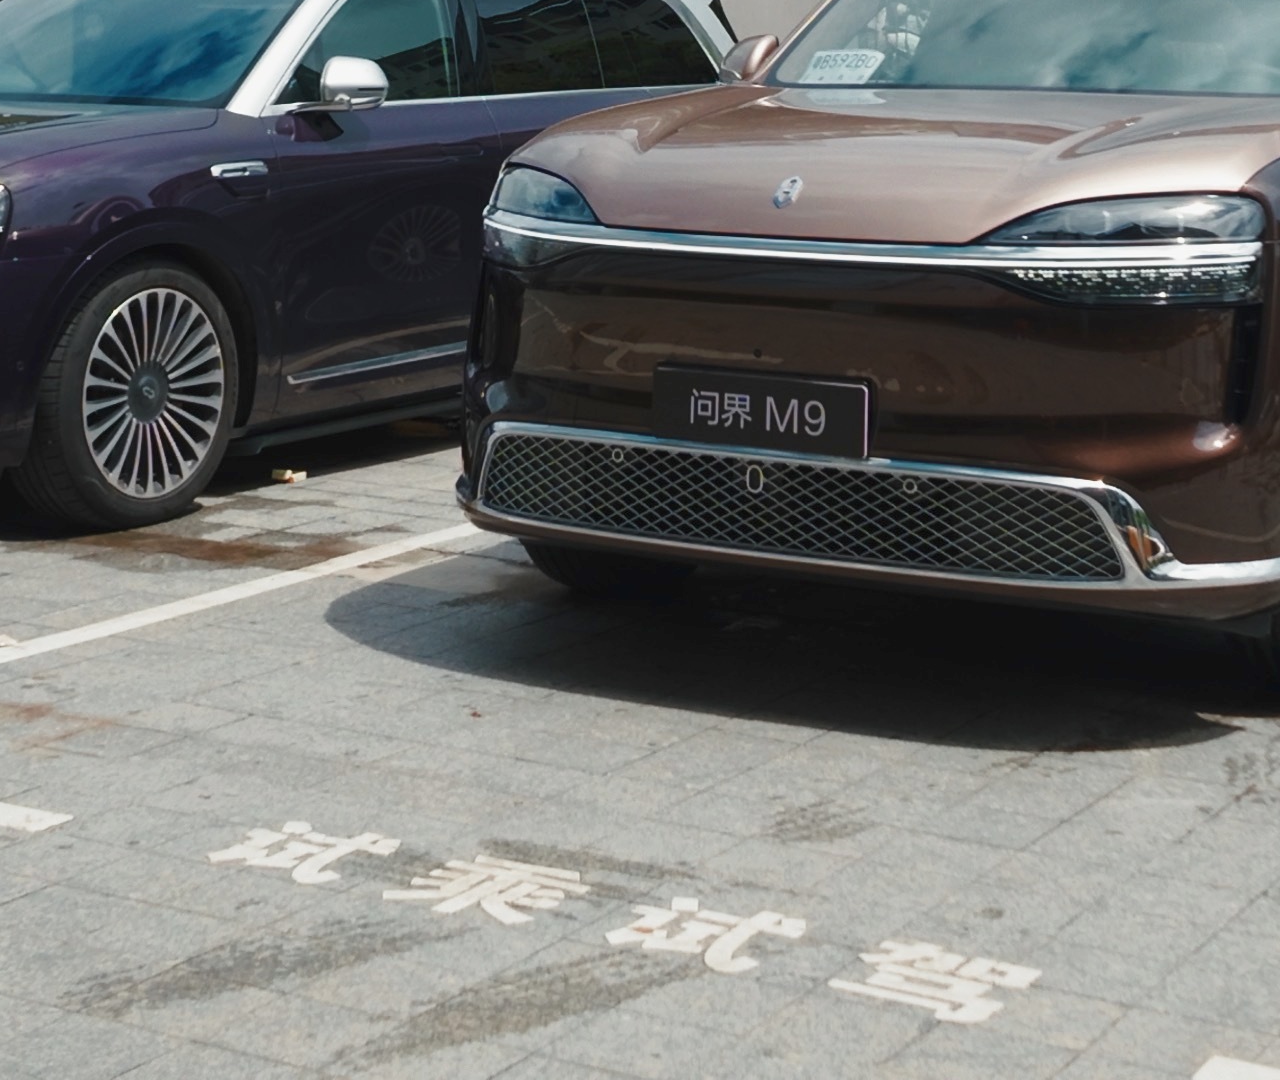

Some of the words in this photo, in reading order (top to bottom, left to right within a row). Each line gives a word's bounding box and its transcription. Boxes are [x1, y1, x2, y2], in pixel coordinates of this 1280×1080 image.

[690, 388, 752, 429] 问界
[765, 396, 826, 437] M9
[206, 820, 1043, 1024] 试乘试驾
